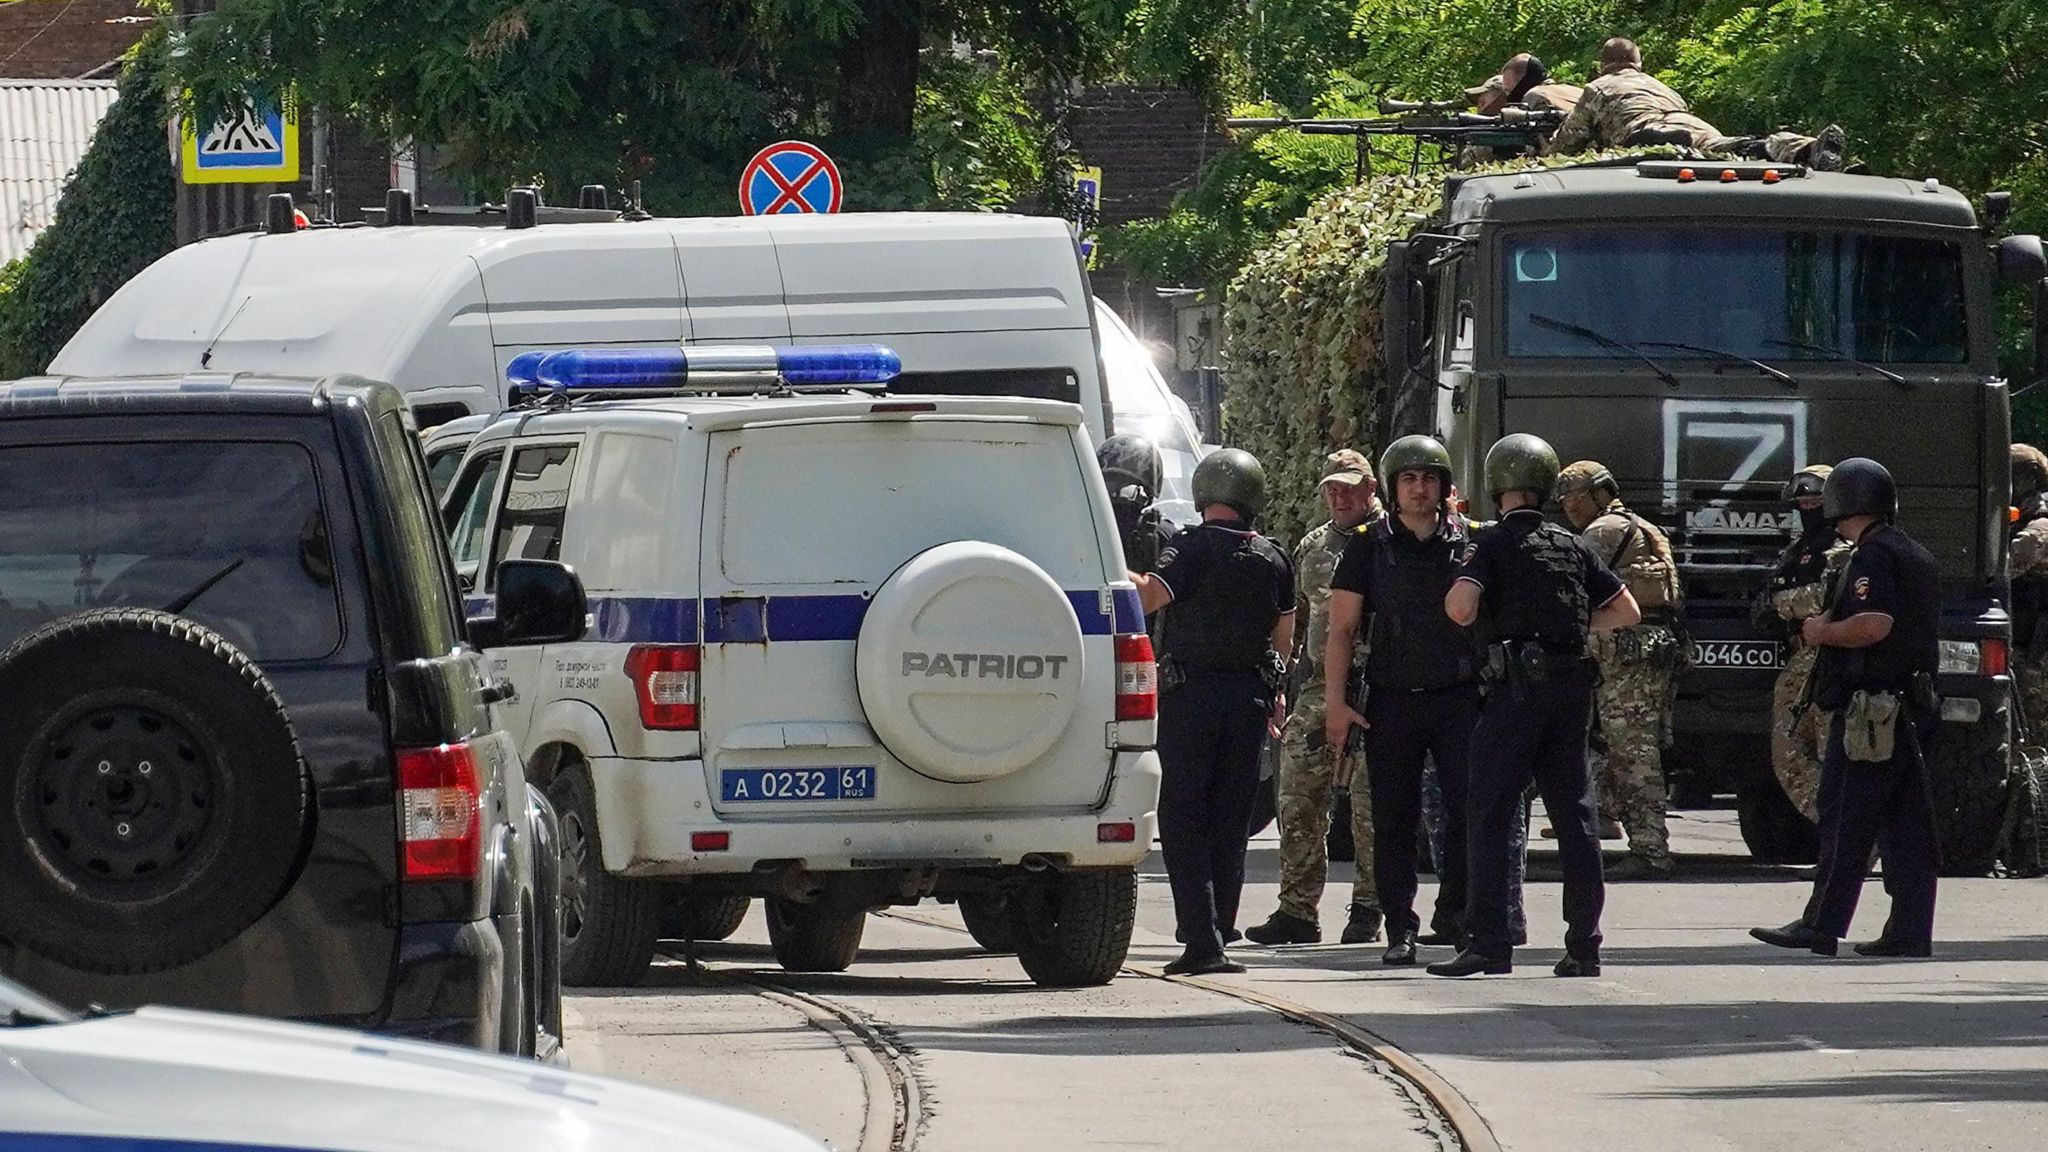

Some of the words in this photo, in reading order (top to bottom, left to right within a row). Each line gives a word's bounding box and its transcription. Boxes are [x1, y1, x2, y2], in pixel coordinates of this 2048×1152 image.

[901, 651, 1069, 680] PATRIOT
[734, 778, 749, 798] A
[761, 771, 826, 798] 0232
[842, 768, 867, 789] 61
[845, 789, 864, 798] RUS
